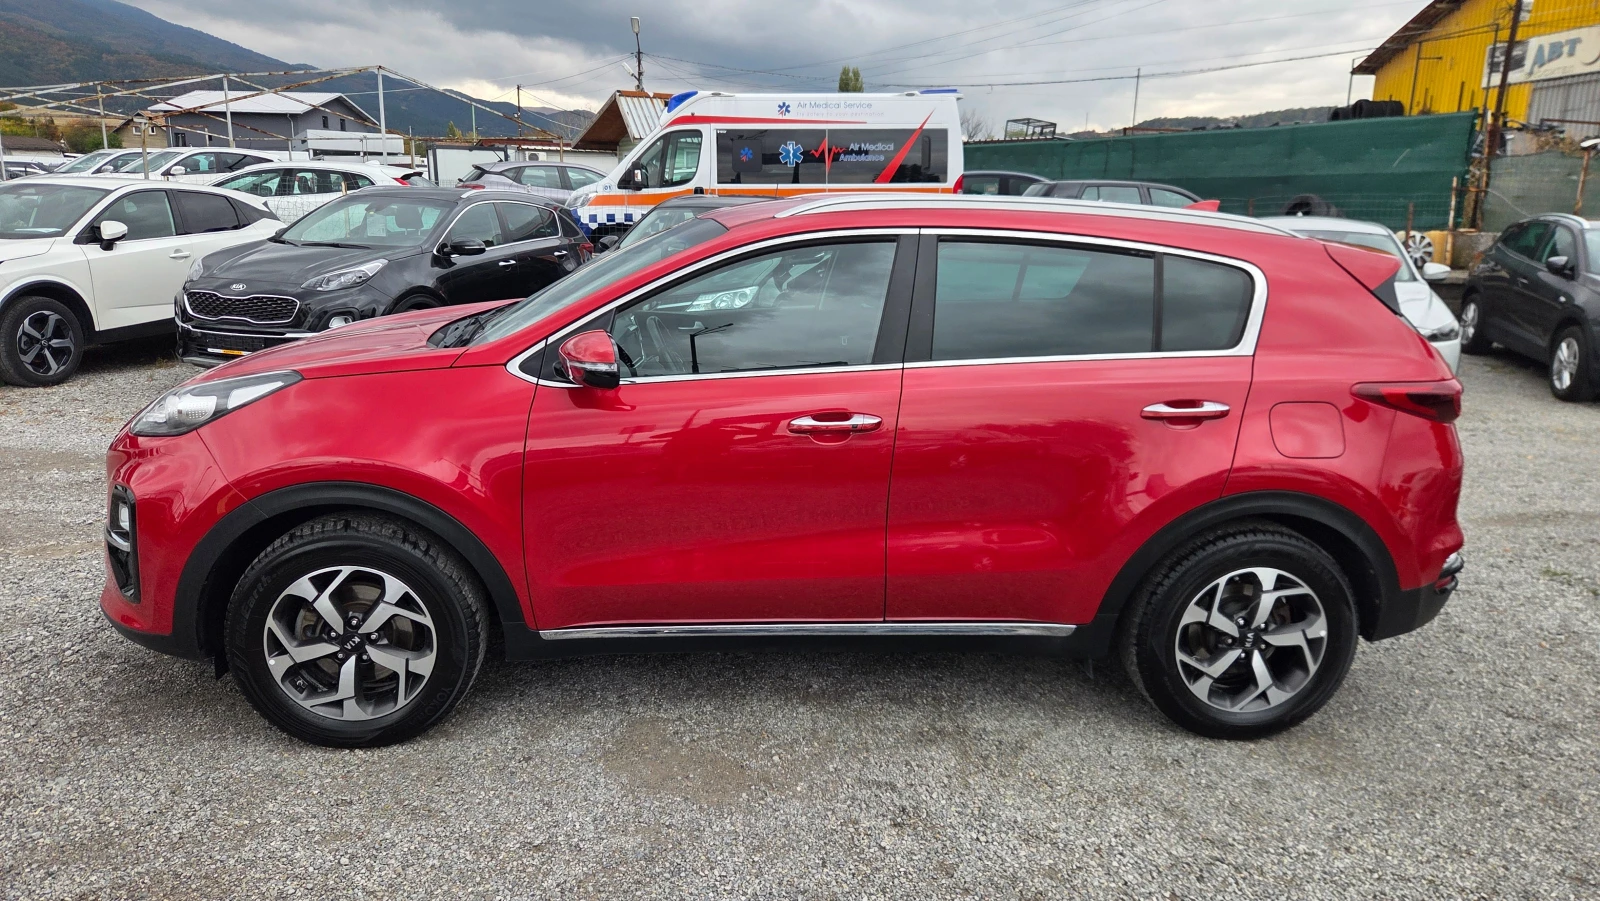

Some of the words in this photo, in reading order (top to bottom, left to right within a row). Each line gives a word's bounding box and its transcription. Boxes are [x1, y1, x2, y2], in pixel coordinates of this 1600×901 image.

[797, 101, 807, 109] Air
[810, 101, 841, 109] Medical
[843, 101, 872, 109] Service
[849, 142, 860, 151] Air
[861, 142, 894, 151] Medical
[838, 153, 885, 162] Ambulance
[344, 636, 361, 650] KIA
[1244, 632, 1255, 648] KIA
